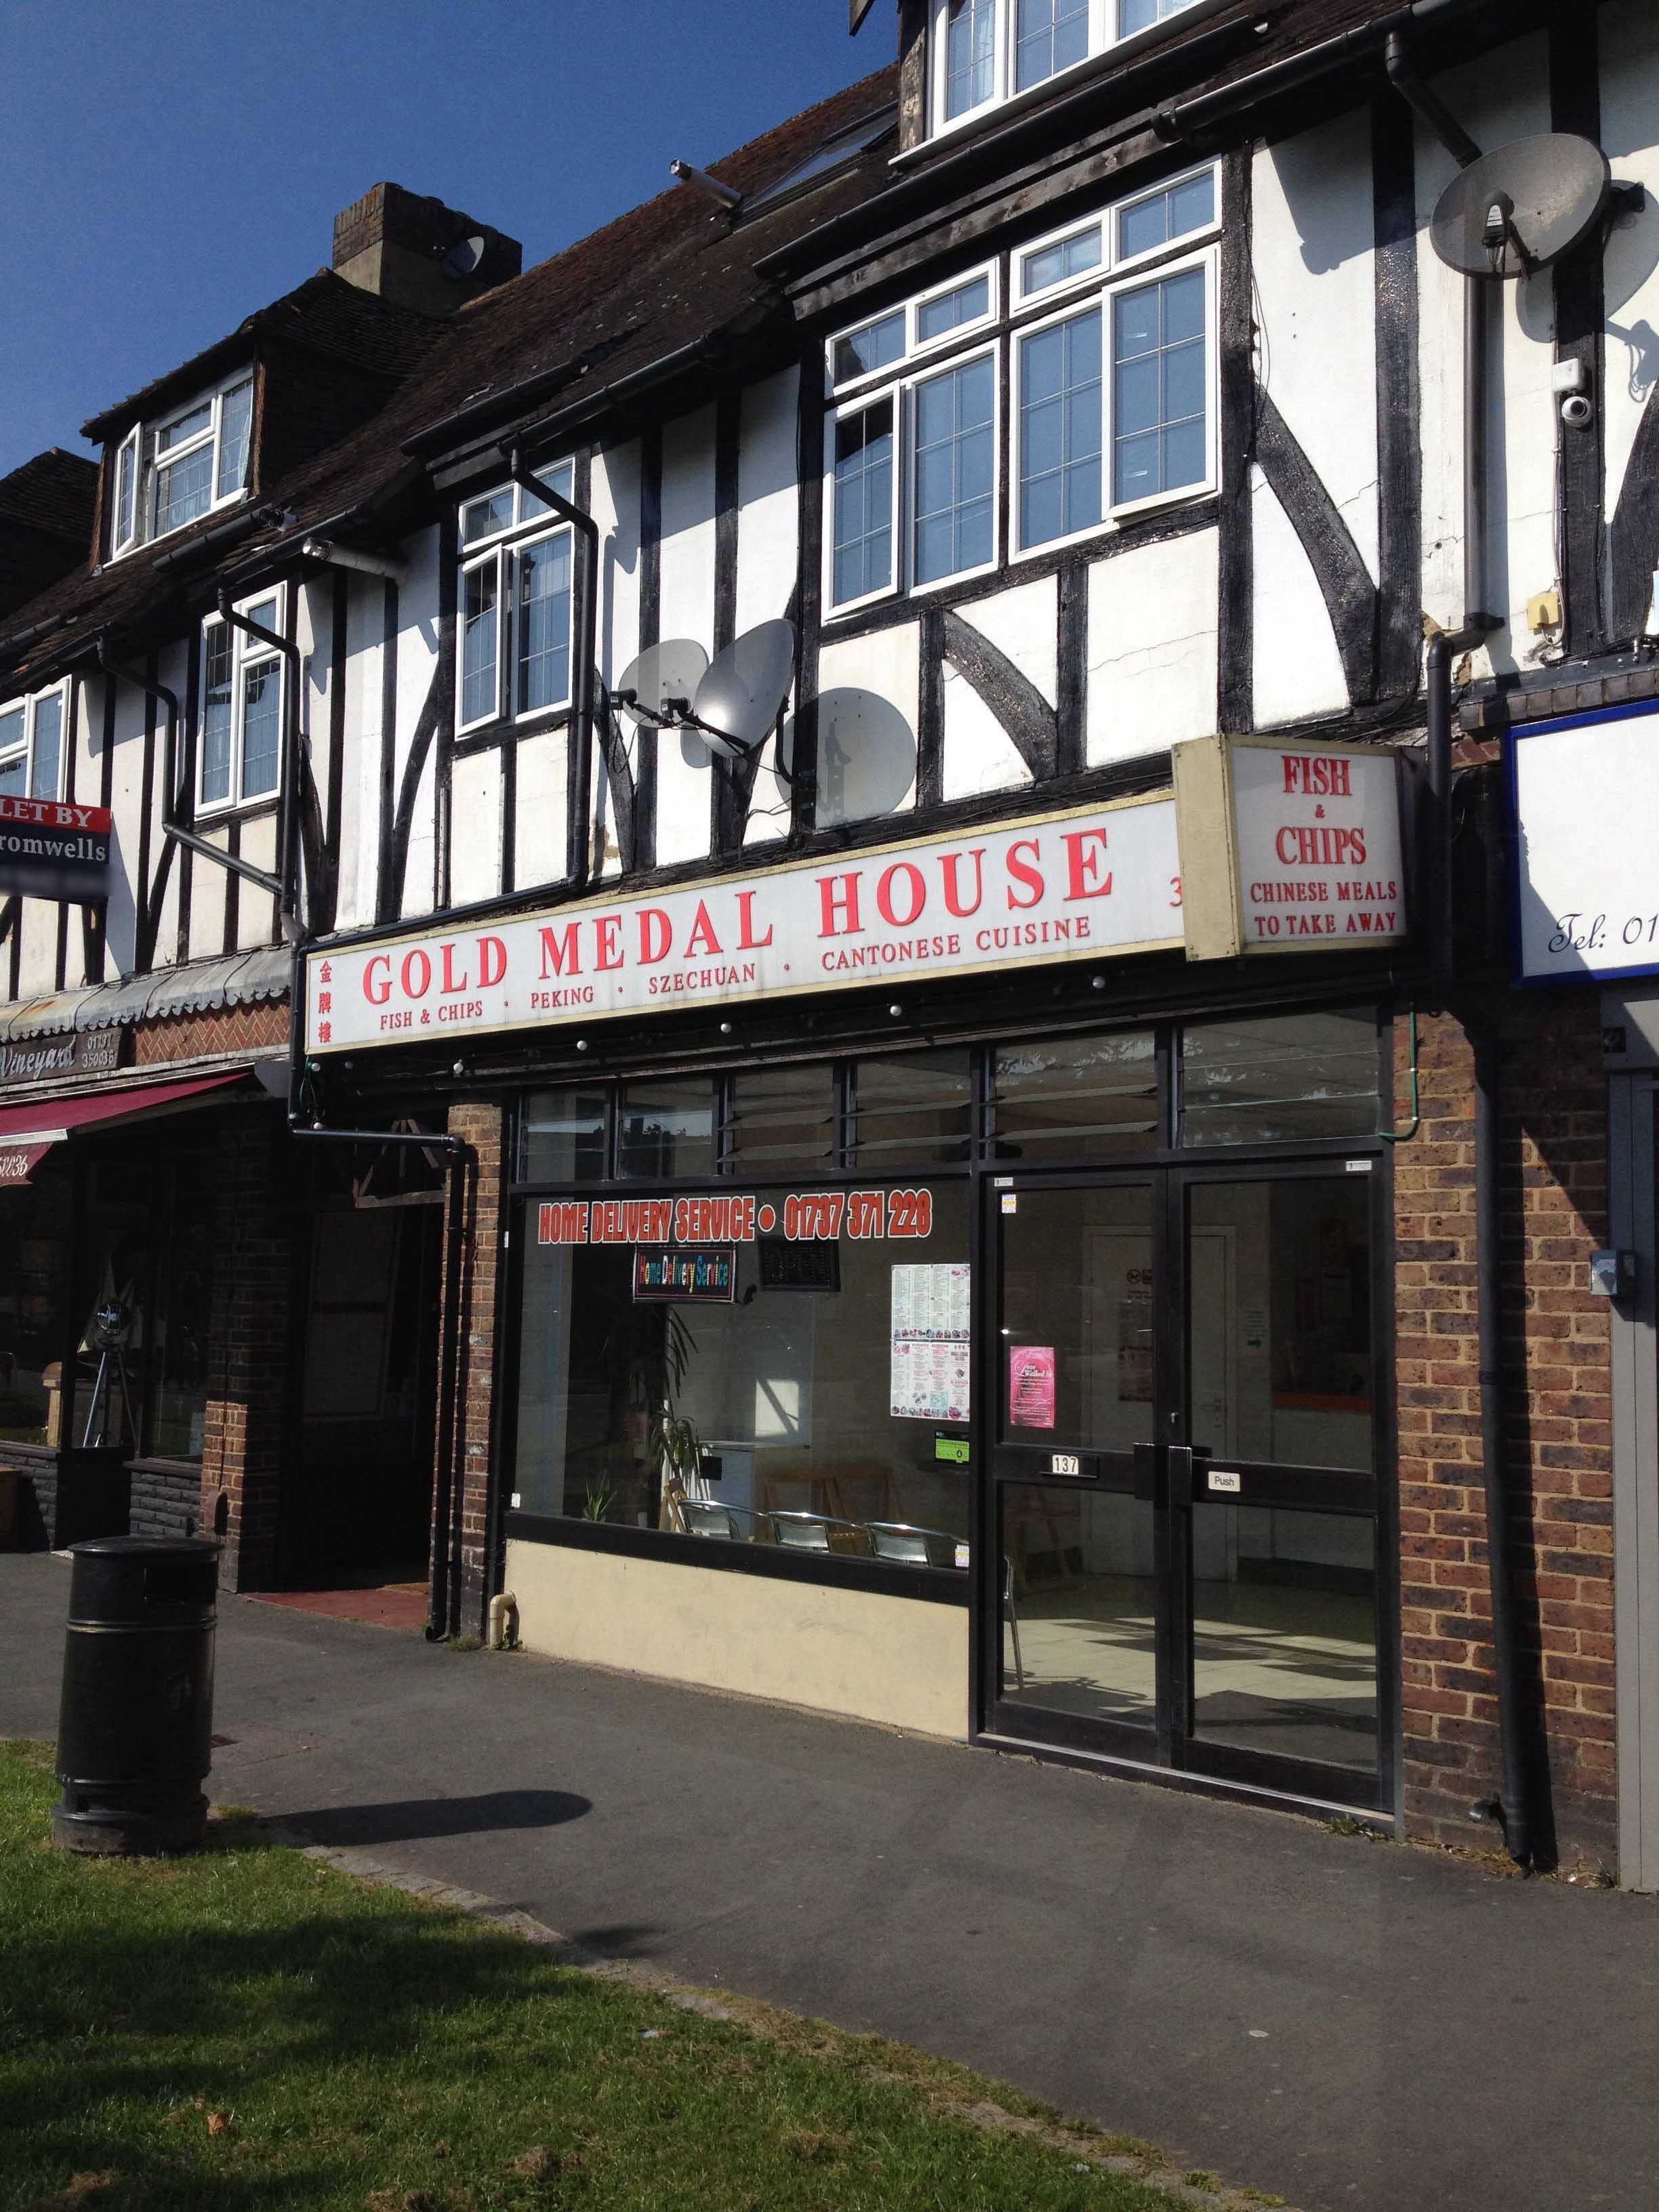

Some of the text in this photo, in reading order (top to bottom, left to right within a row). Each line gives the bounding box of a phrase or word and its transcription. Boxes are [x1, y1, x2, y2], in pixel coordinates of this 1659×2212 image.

[1281, 755, 1352, 796] FISH
[0, 798, 92, 827] LET BY
[1315, 804, 1326, 819] &
[1275, 826, 1367, 865] CHIPS
[1250, 881, 1397, 902] CHINESE MEALS
[362, 827, 1113, 1005] GOLD MEDAL HOUSE
[1254, 912, 1396, 936] TO TAKE AWAY
[1548, 913, 1659, 953] Tel: 01
[380, 916, 1091, 1030] FISH & CHIPS PEKING SZECHUAN CANTONESE CUISINE
[318, 960, 332, 1044] 金牌樓
[0, 1034, 76, 1080] Vineyard
[82, 1050, 115, 1068] 350036
[87, 1033, 112, 1050] 01737
[538, 1188, 933, 1244] HOME DELIVERY SERVICE 01737 371 228
[639, 1254, 661, 1285] Home
[662, 1254, 695, 1294] Delivery
[696, 1254, 729, 1287] Service
[1054, 1457, 1077, 1473] 137
[1214, 1475, 1234, 1486] Push
